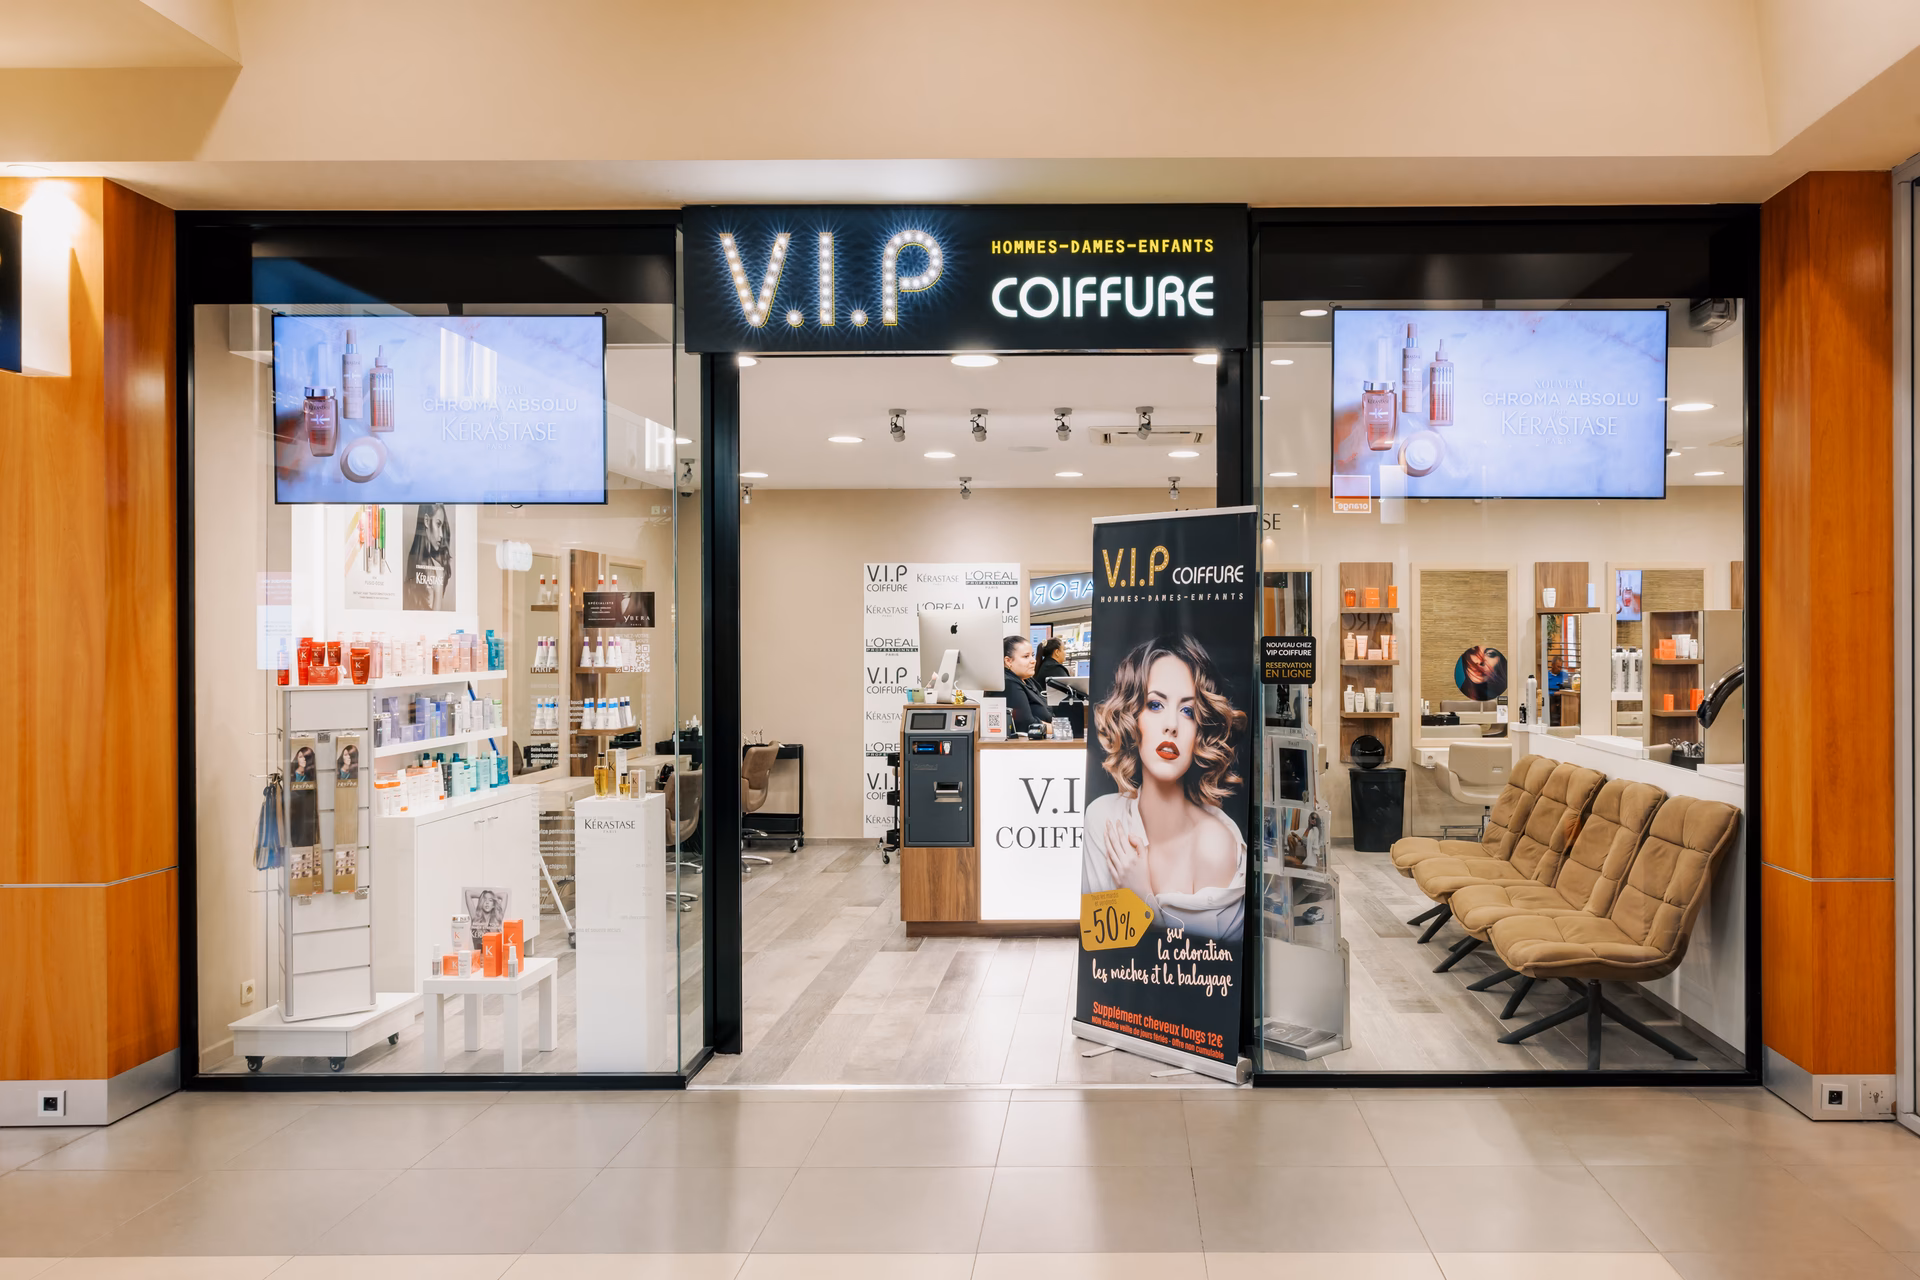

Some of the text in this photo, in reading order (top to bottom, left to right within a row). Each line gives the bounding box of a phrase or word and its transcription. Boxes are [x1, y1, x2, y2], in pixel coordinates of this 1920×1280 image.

[991, 239, 1214, 254] HOMMES-DAMES-ENFANTS
[719, 229, 944, 328] V.I.P
[991, 275, 1214, 318] COIFFURE
[1534, 379, 1585, 389] NOUVEAU
[422, 398, 578, 412] CHROMA ABSOLU
[1482, 392, 1639, 406] CHROMA ABSOLU
[442, 416, 557, 441] KÉRASTASE
[1501, 410, 1618, 435] KÉRASTASE
[867, 565, 908, 582] V.I.P
[1102, 545, 1170, 588] V.I.P
[916, 573, 960, 583] KÉRASTASE
[965, 570, 1018, 581] L'ORÉAL
[1172, 565, 1244, 585] COIFFURE
[867, 583, 908, 592] COIFFURE
[1100, 592, 1244, 603] HOMMES-DAMES-ENFANTS
[866, 604, 908, 614] KÉRASTASE
[866, 637, 918, 648] L'ORÉAL
[867, 667, 908, 684] V.I.P
[1265, 669, 1312, 678] EN LIGNE
[866, 711, 903, 721] KÉRASTAS
[584, 819, 636, 829] KÉRASTASE
[1083, 906, 1135, 944] -50%
[1166, 927, 1185, 943] sur
[1157, 938, 1234, 962] la coloration
[1092, 958, 1234, 997] les mèches et le balayage
[1093, 1001, 1223, 1048] Supplément cheveux longs 12€
